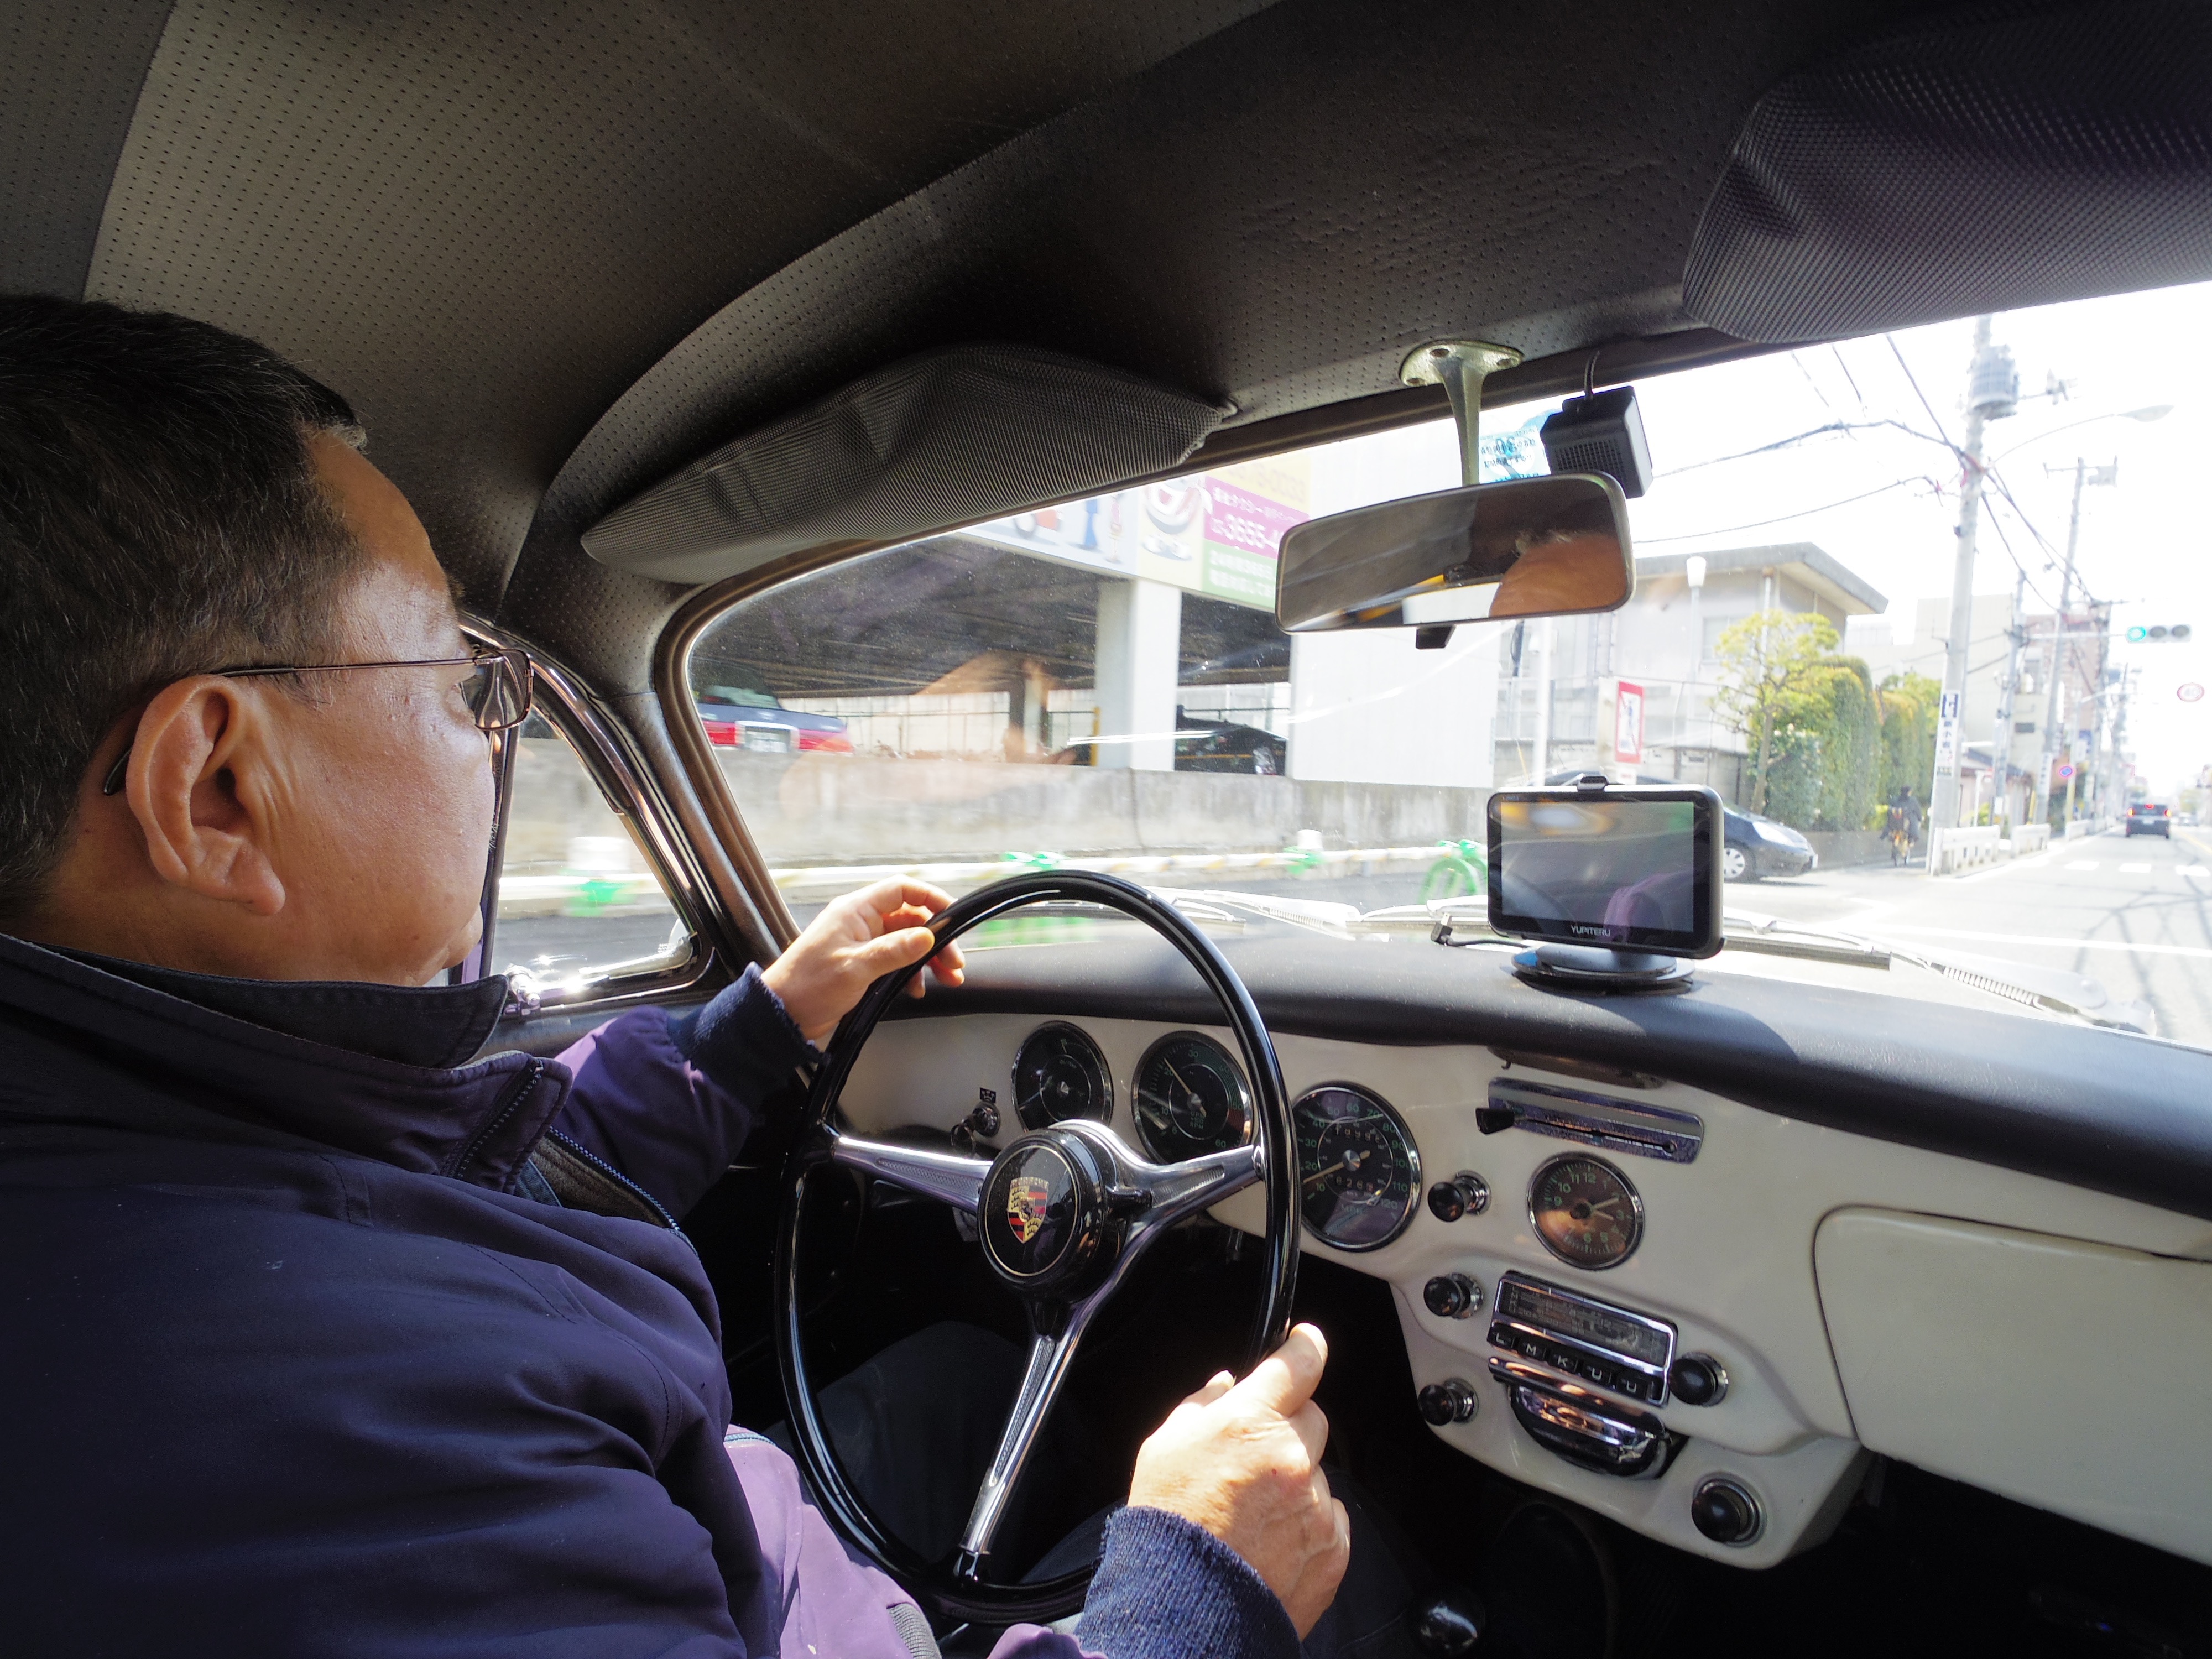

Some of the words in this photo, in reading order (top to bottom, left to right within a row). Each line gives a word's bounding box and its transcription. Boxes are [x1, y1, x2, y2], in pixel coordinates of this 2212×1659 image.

[1571, 925, 1611, 937] YUPITERU
[1188, 1050, 1198, 1058] 30
[1164, 1068, 1174, 1076] 20
[1162, 1106, 1168, 1115] 10
[1346, 1102, 1359, 1112] 60
[1383, 1123, 1396, 1133] 80
[1215, 1139, 1227, 1148] 60
[1305, 1139, 1317, 1148] 30
[1391, 1140, 1405, 1151] 90
[1306, 1162, 1317, 1171] 20
[1571, 1173, 1580, 1184] 11
[1583, 1172, 1596, 1183] 12
[1316, 1182, 1326, 1192] 10
[1393, 1181, 1408, 1192] 110
[1558, 1182, 1571, 1194] 10
[1553, 1195, 1562, 1206] 9
[1616, 1209, 1624, 1221] 3
[1583, 1233, 1592, 1244] 6
[1600, 1232, 1609, 1243] 5
[1496, 1332, 1504, 1344] L
[1526, 1343, 1536, 1355] M
[1558, 1355, 1568, 1367] K
[1592, 1367, 1602, 1380] U
[1626, 1380, 1637, 1393] U
